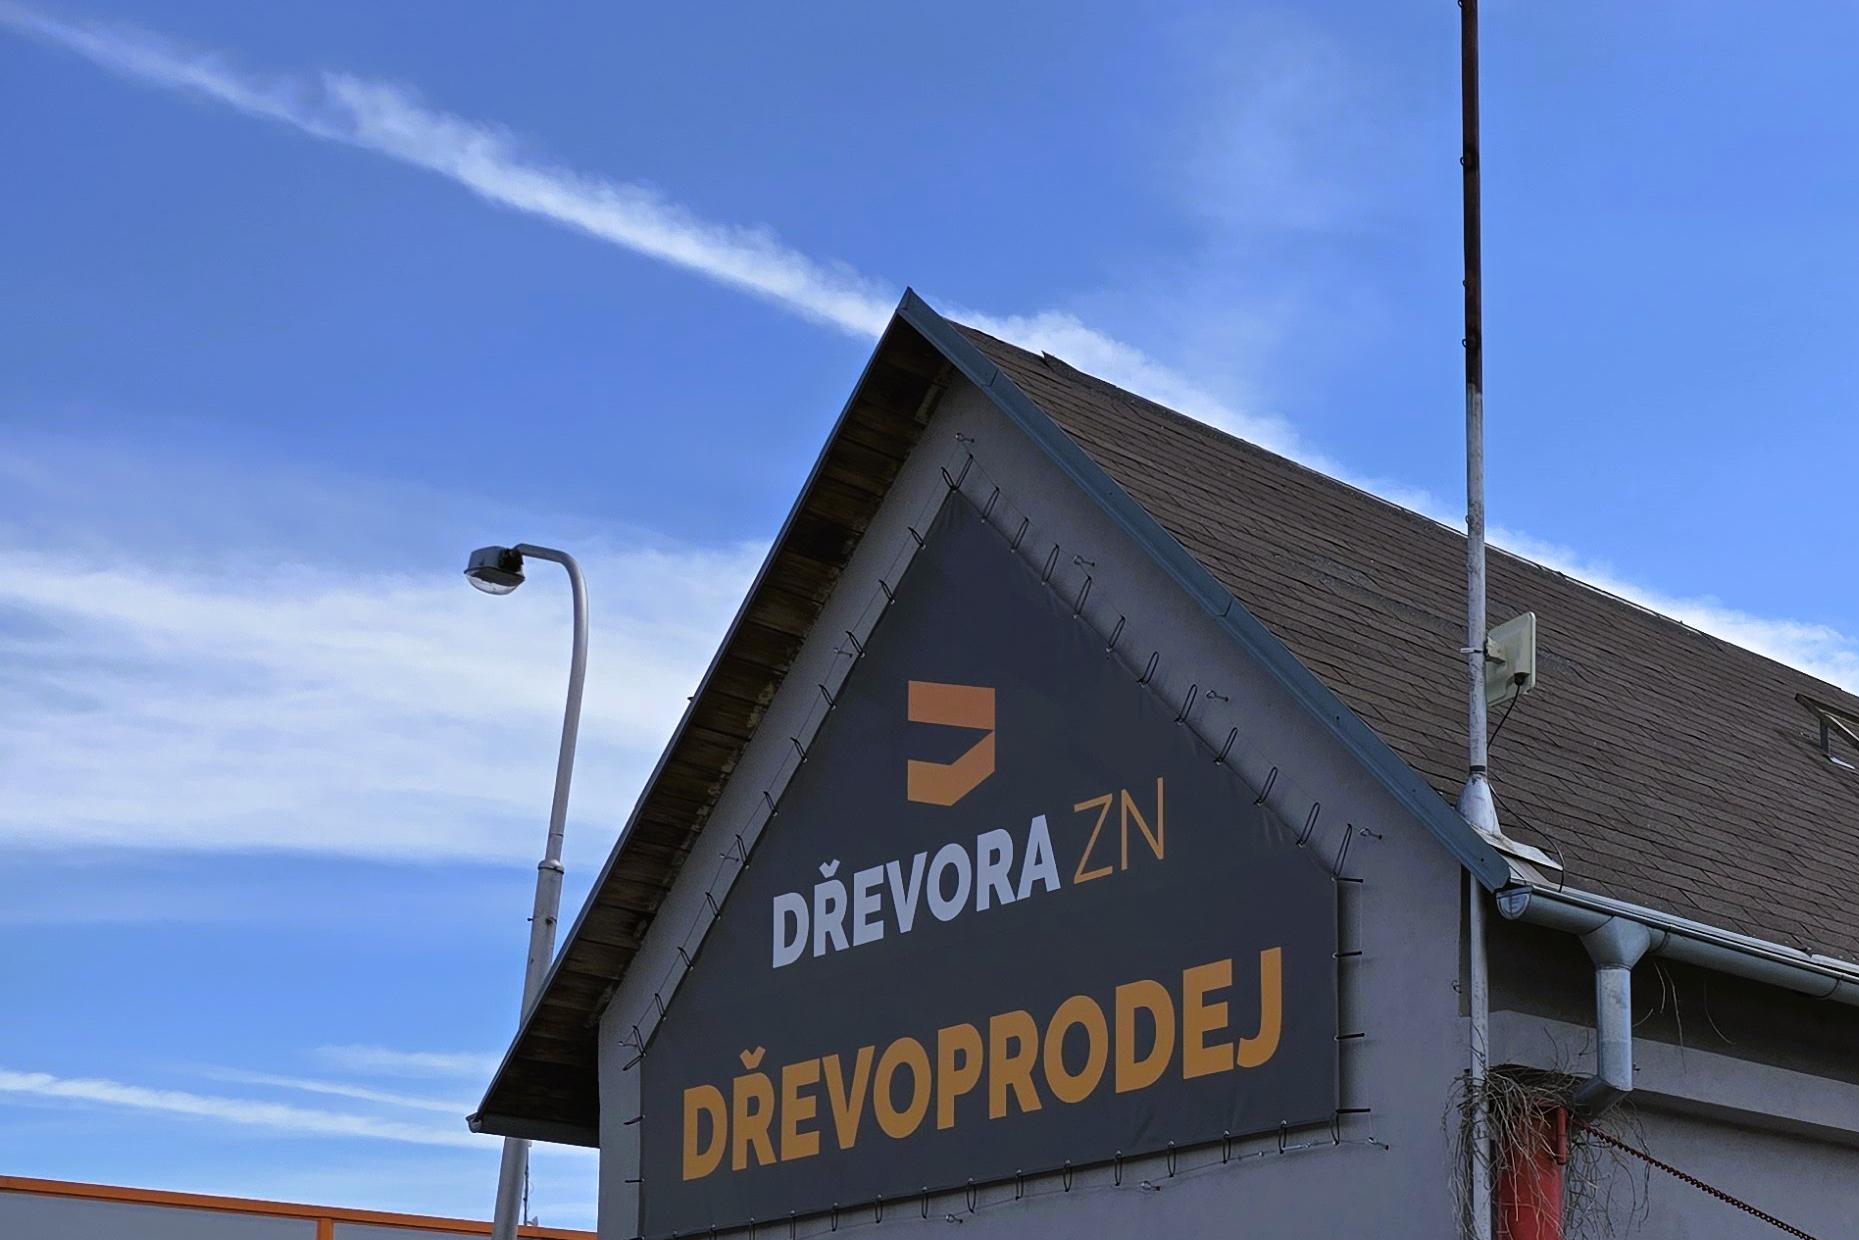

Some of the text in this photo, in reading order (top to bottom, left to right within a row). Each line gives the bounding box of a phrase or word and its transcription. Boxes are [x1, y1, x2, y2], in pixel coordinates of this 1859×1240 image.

[772, 777, 1164, 968] DŘEVORA ZN
[682, 947, 1282, 1181] DŘEVOPRODEJ
